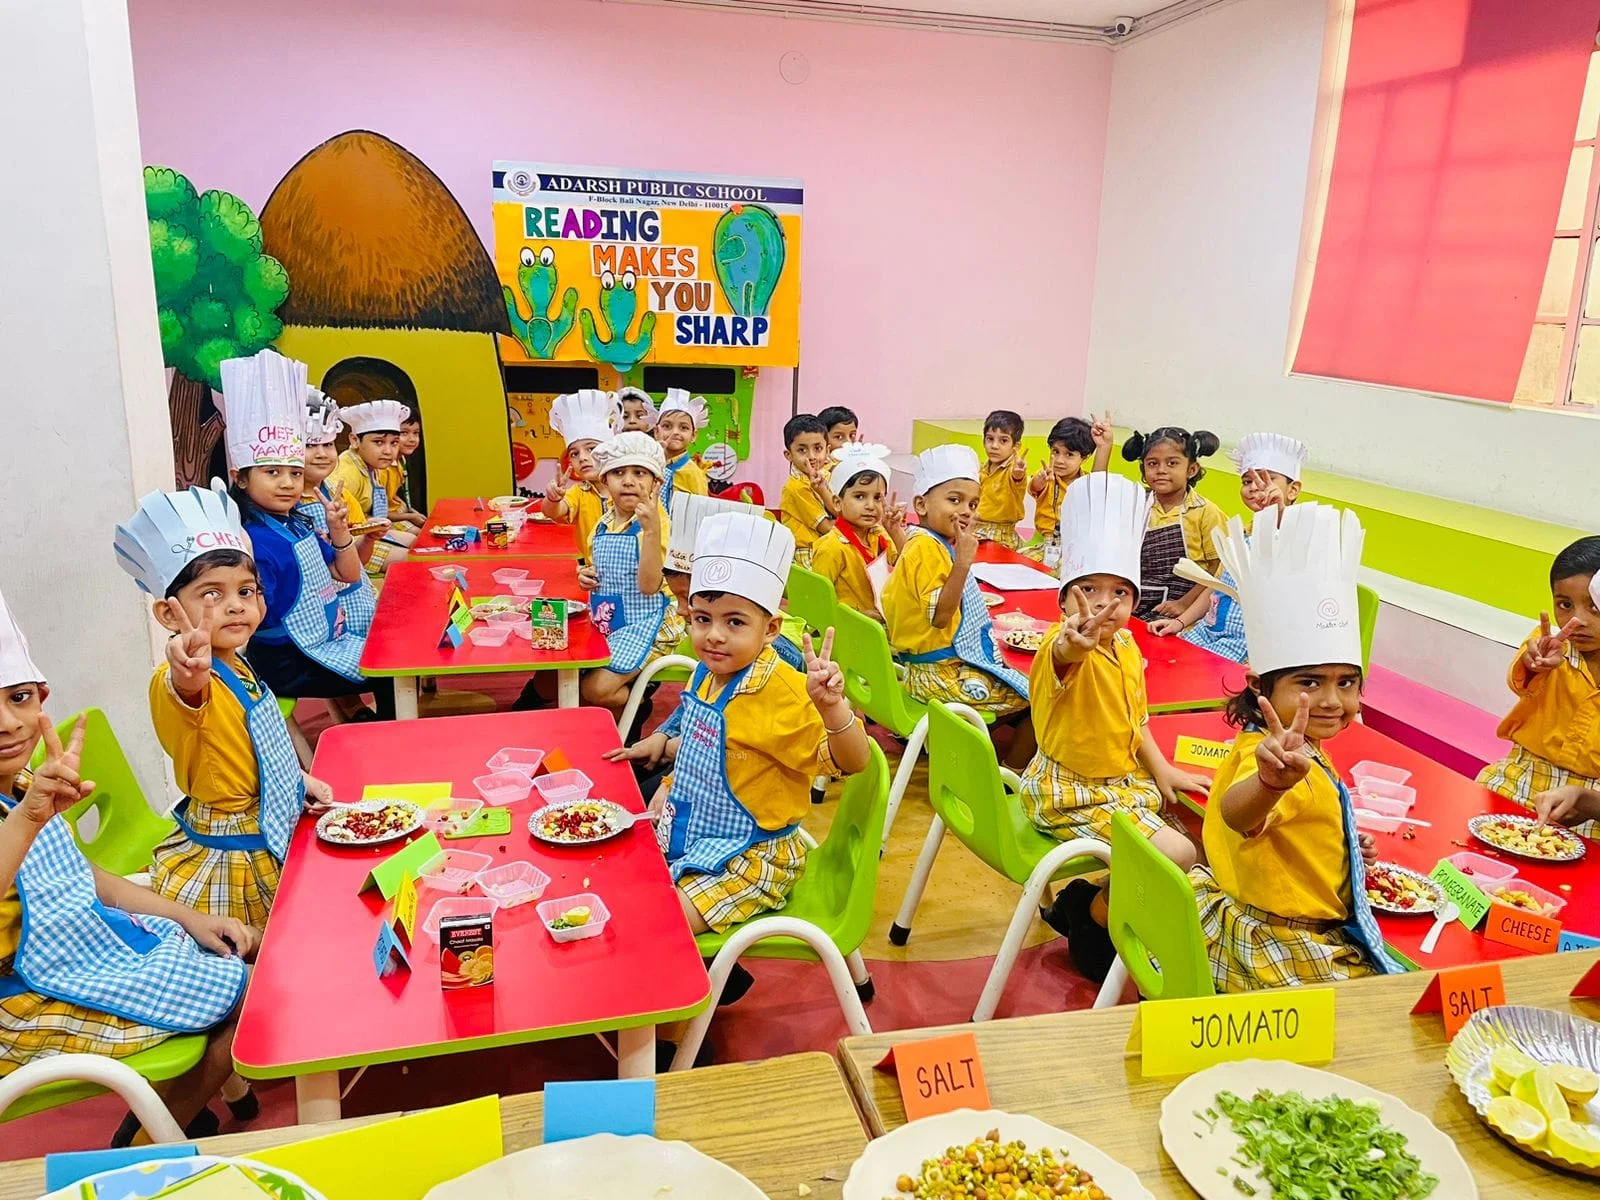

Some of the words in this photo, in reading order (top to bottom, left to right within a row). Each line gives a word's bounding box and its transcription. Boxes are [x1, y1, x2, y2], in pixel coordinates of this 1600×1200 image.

[547, 177, 621, 193] ADARSH
[627, 182, 691, 196] PUBLIC
[695, 186, 767, 201] SCHOOL
[588, 195, 617, 203] F-Block
[636, 199, 659, 207] Nagar,
[525, 206, 660, 242] READING
[593, 245, 695, 277] MAKES
[651, 281, 711, 312] YOU
[676, 315, 768, 346] SHARP
[258, 425, 294, 443] CHEF
[196, 531, 243, 549] CHEF
[1434, 868, 1485, 919] POMEGRANATE
[1501, 917, 1552, 944] CHEESE
[1449, 986, 1492, 1017] SALT
[1191, 1008, 1299, 1049] JOMATO
[916, 1058, 975, 1098] SALT
